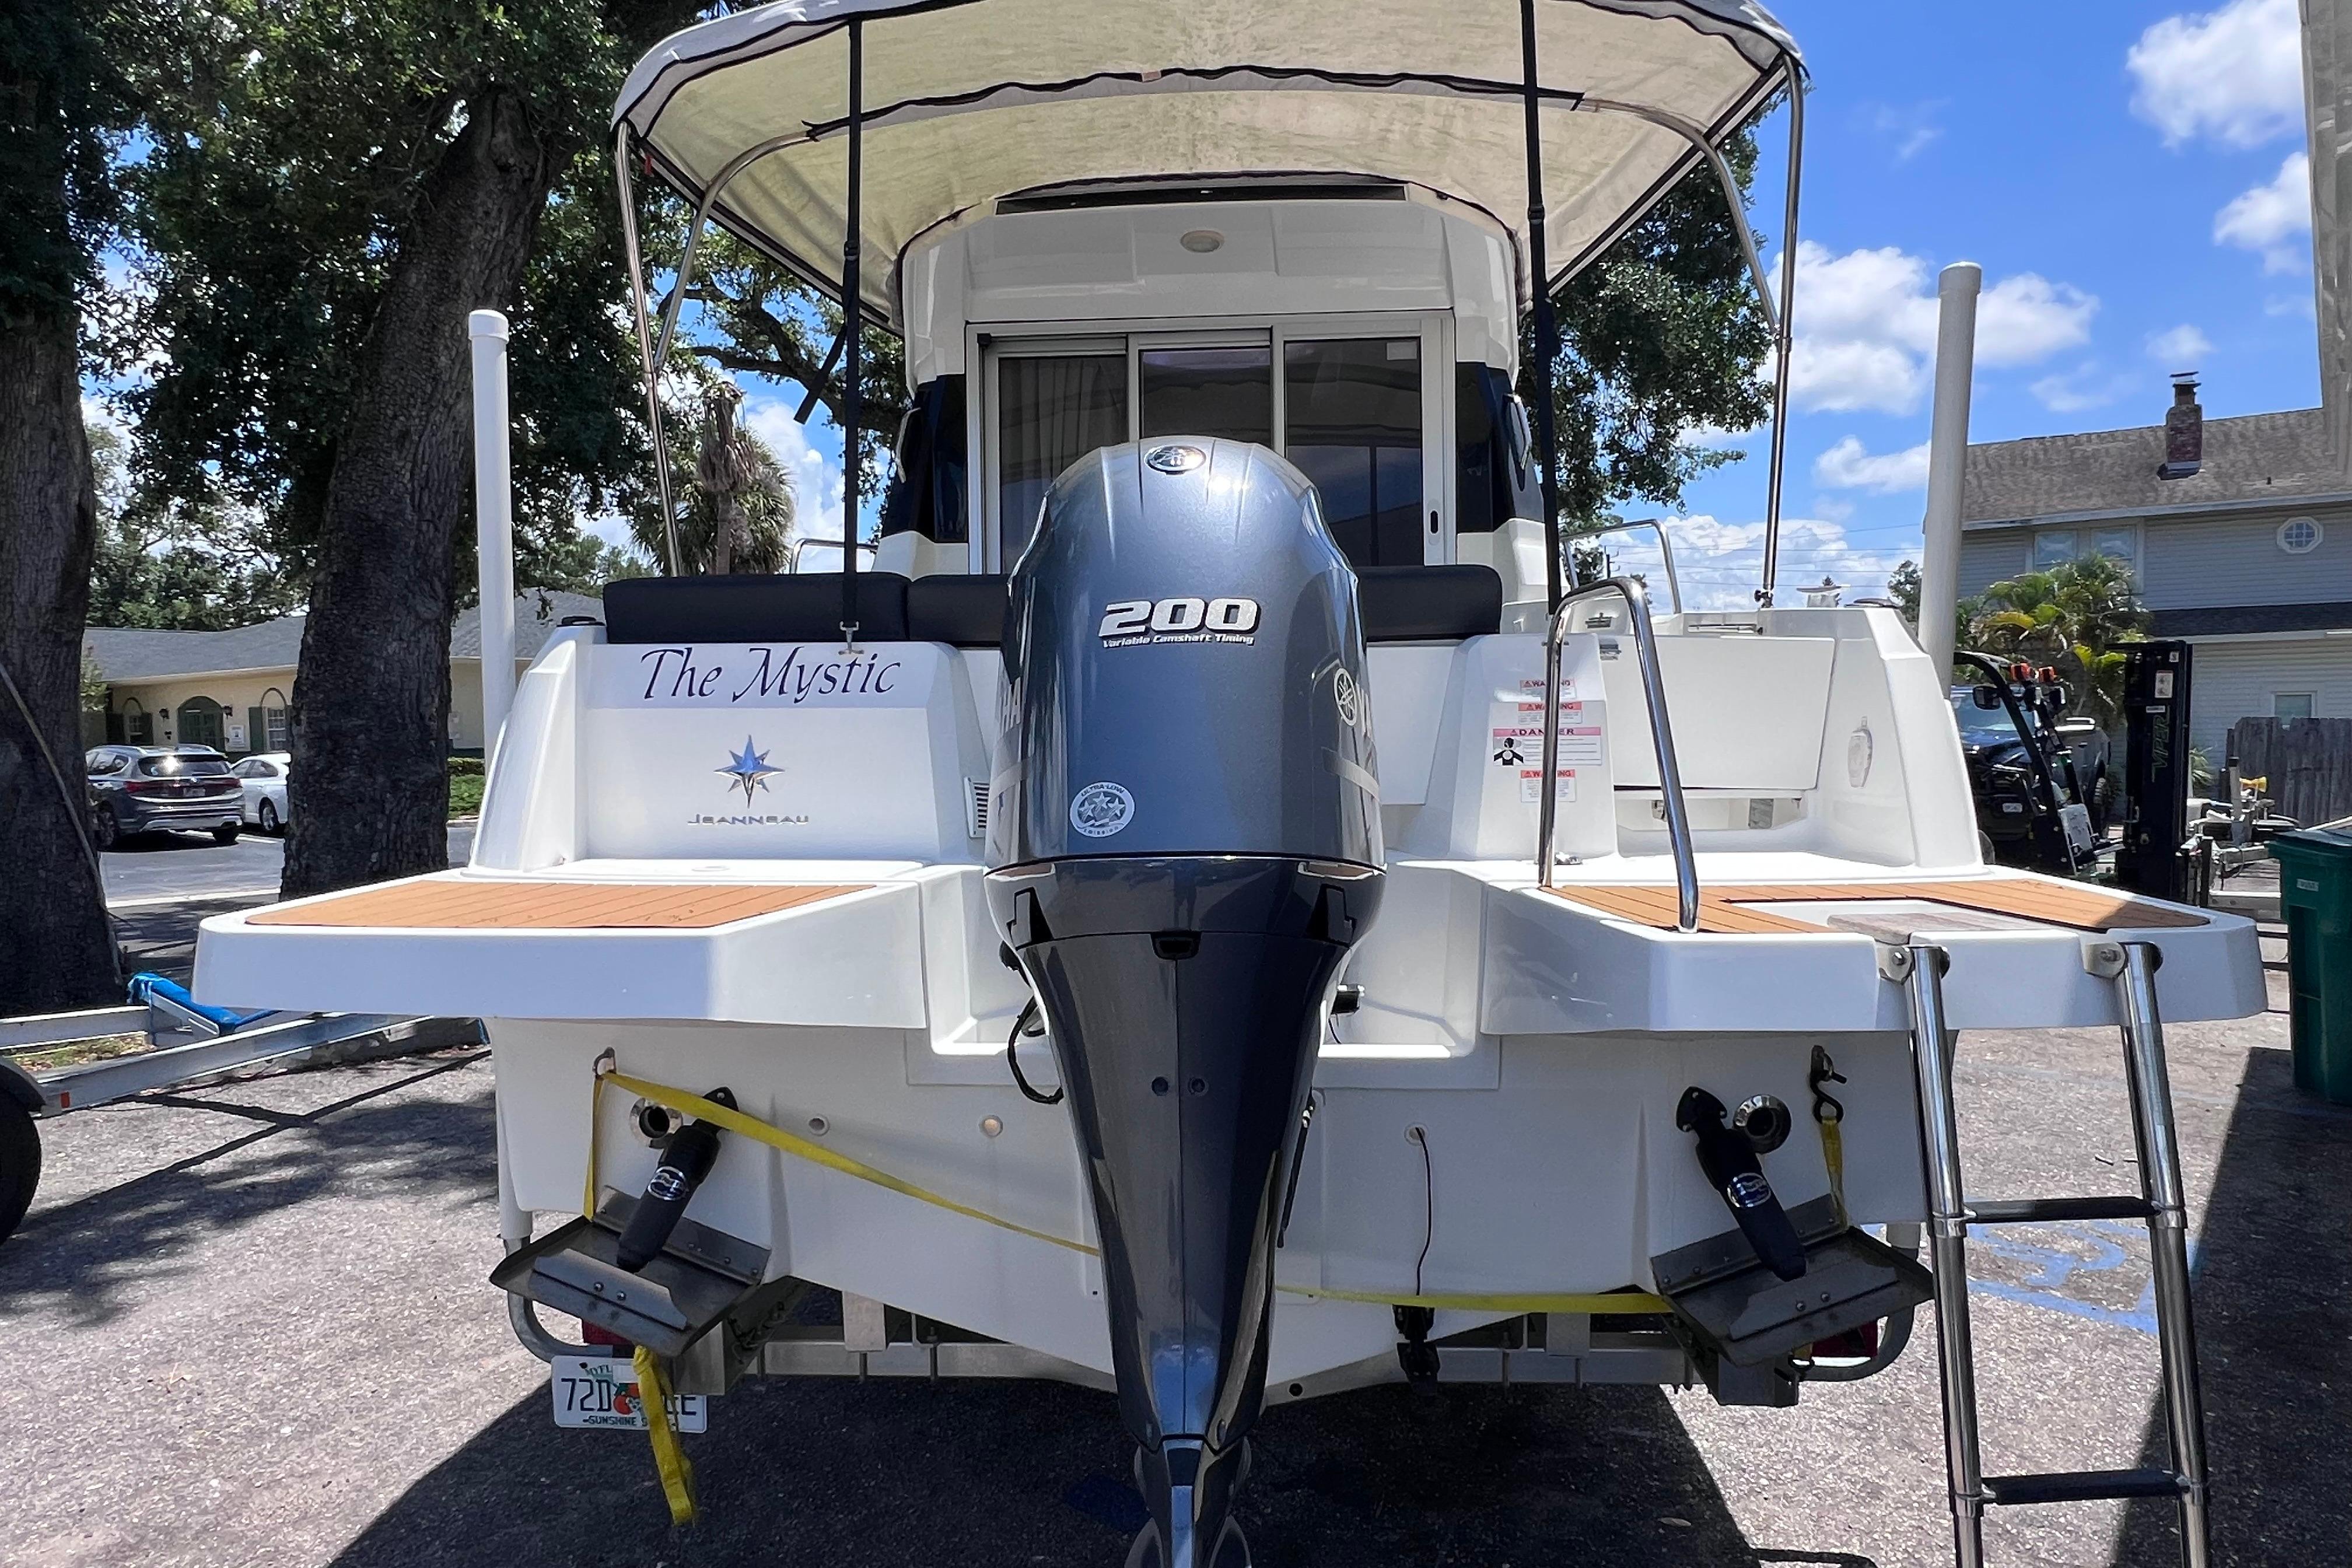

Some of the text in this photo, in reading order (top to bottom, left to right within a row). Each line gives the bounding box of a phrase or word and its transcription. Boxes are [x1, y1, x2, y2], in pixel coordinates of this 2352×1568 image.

[1098, 598, 1259, 637] 200
[1103, 634, 1254, 648] Variable Camshaft Timing
[640, 646, 901, 704] The Mystic
[687, 813, 809, 825] JEANNEAU
[588, 1415, 637, 1426] SUNSHINE
